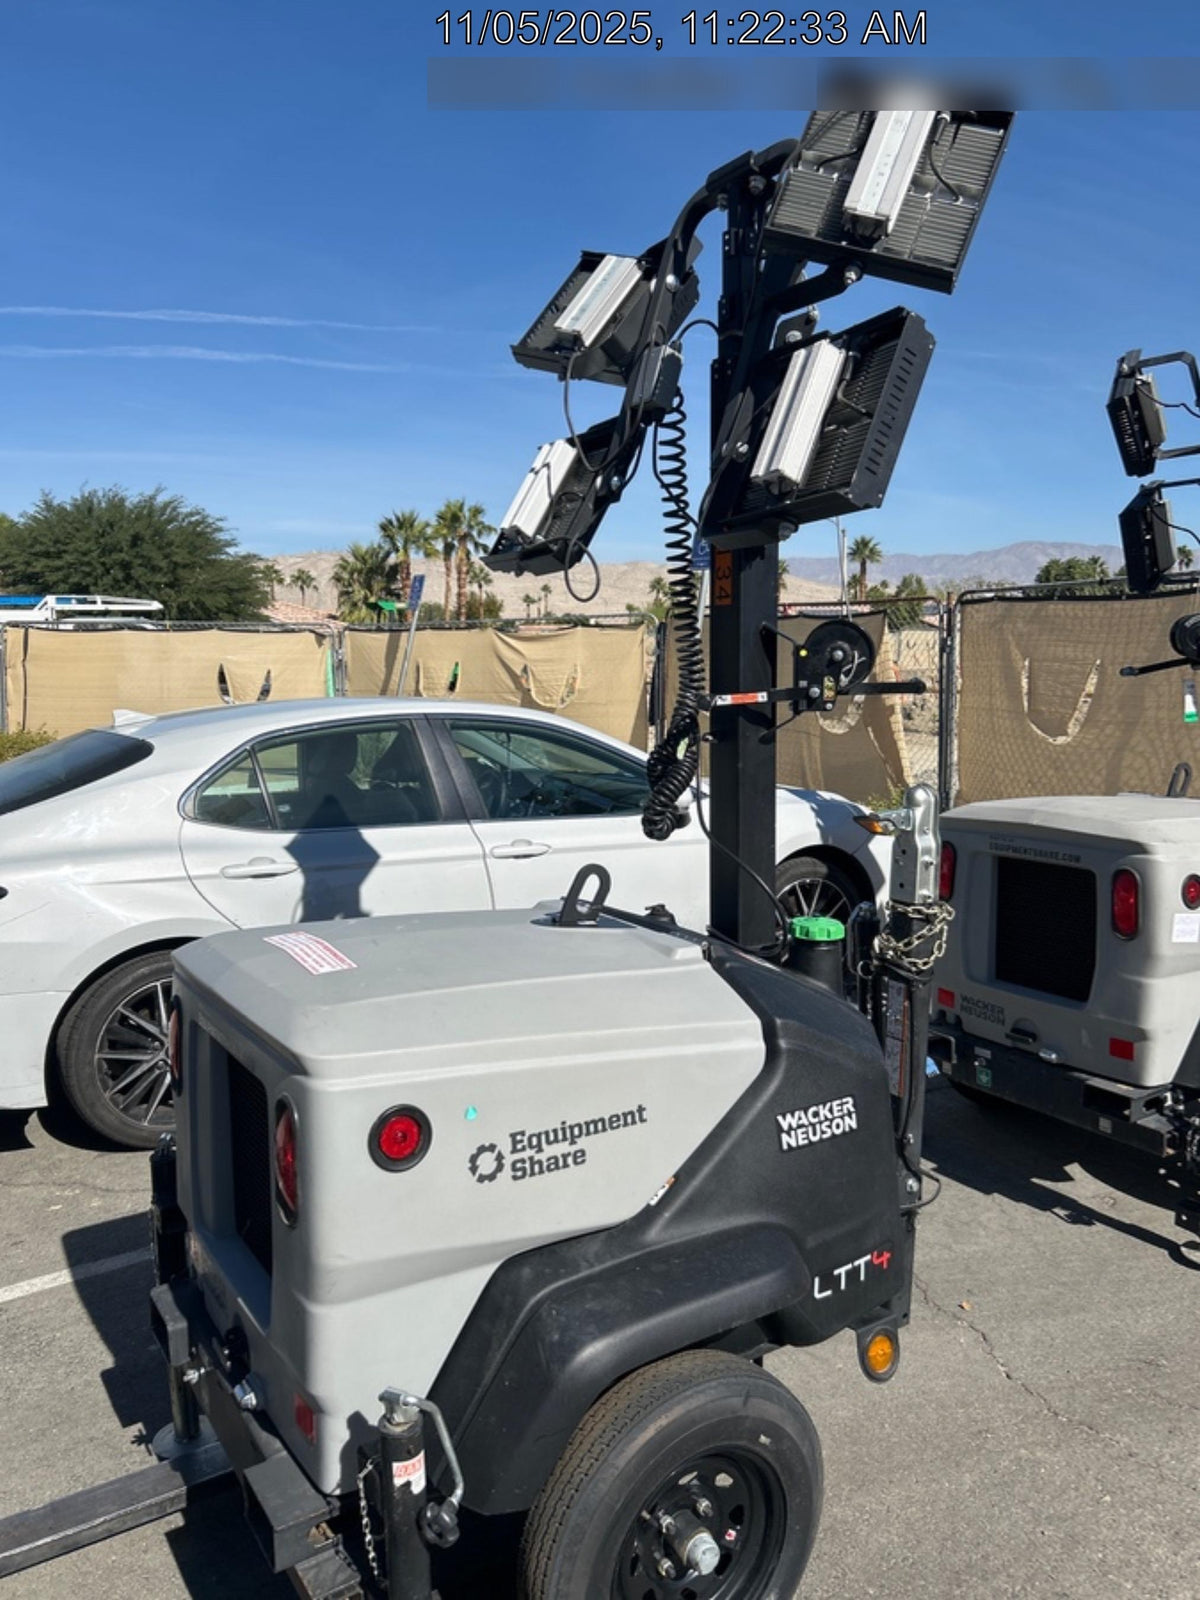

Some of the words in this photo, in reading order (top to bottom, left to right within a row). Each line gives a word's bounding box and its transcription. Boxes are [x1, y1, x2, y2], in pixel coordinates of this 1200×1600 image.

[960, 993, 1005, 1015] WACKER
[960, 1004, 1006, 1026] NEUSON
[509, 1104, 648, 1155] Equipment
[776, 1096, 856, 1131] WACKER
[780, 1113, 858, 1150] NEUSON
[511, 1147, 587, 1182] Share
[813, 1250, 892, 1299] LTT4
